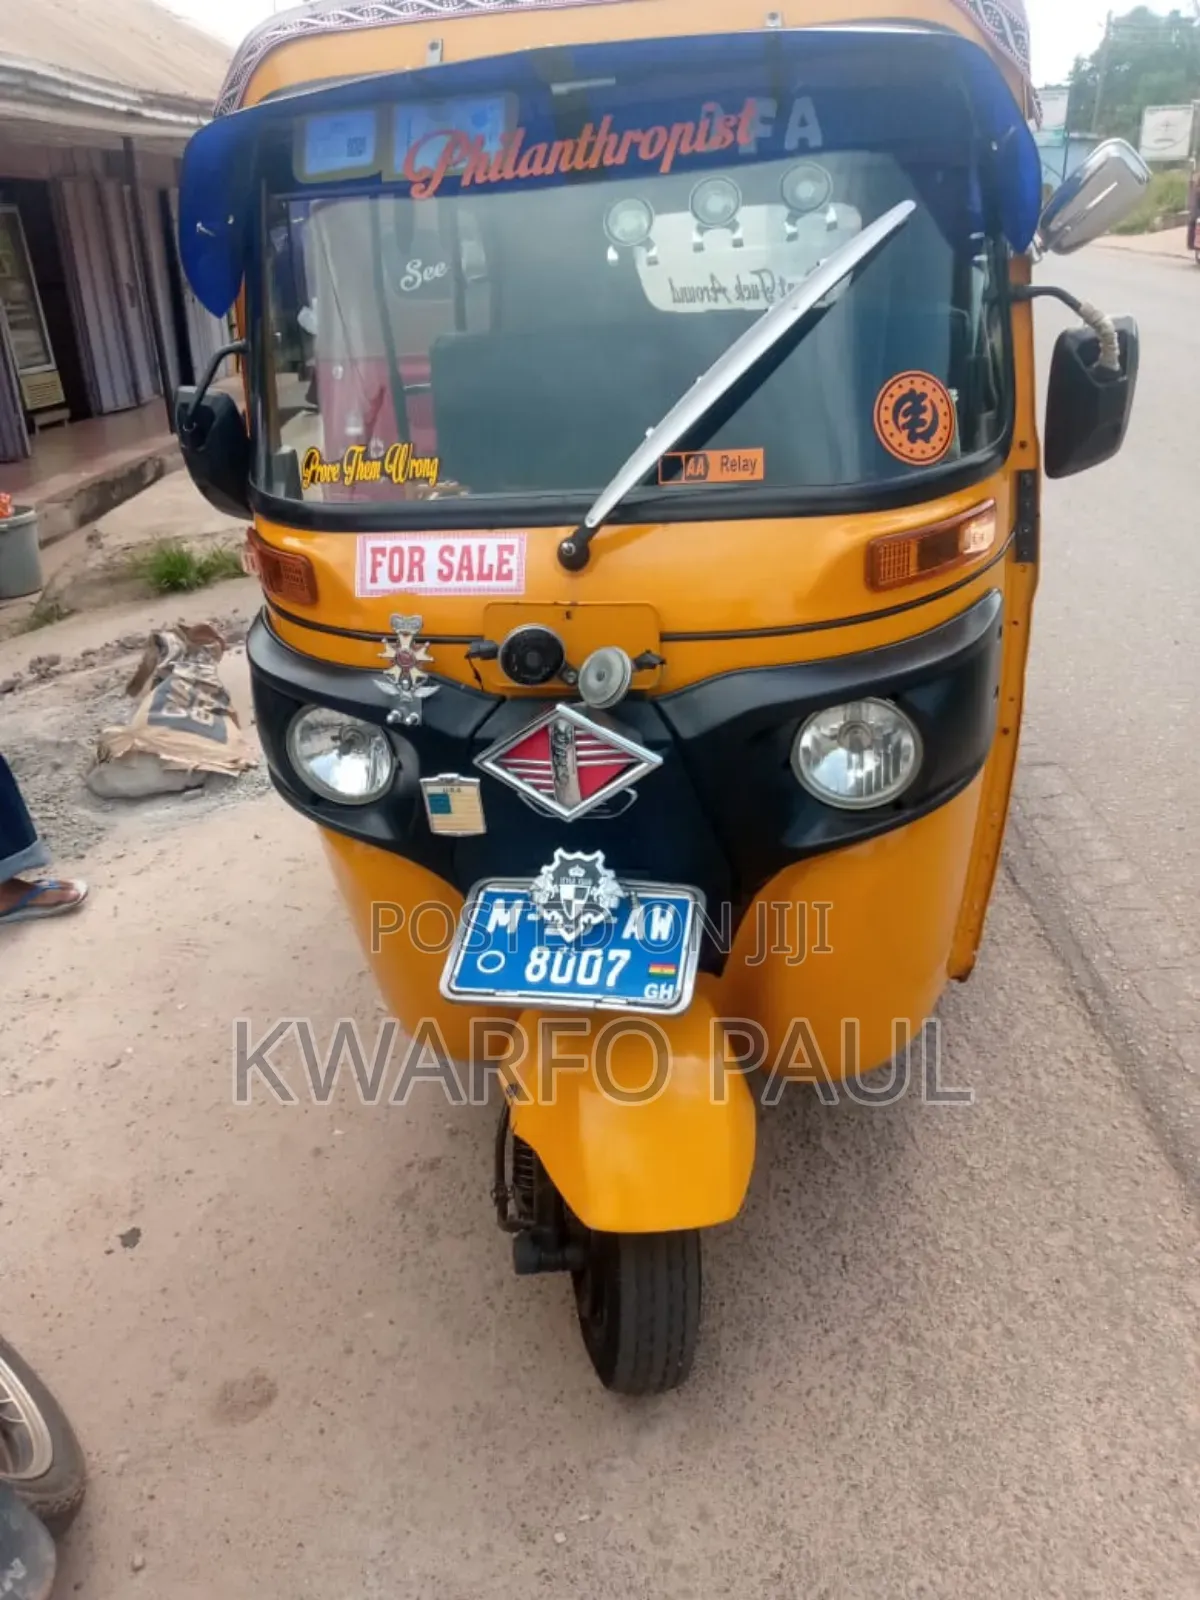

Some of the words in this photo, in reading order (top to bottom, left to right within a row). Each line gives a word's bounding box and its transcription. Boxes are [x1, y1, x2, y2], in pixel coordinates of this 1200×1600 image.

[403, 97, 757, 199] Philanthropist
[400, 259, 450, 291] See
[302, 447, 340, 489] Prove
[343, 444, 382, 486] Them
[384, 442, 439, 487] Wrong
[686, 455, 705, 477] AA
[720, 454, 758, 475] Relay
[369, 545, 426, 584] FOR
[437, 544, 515, 583] SALE
[523, 946, 632, 988] 8007
[643, 983, 675, 1001] GH
